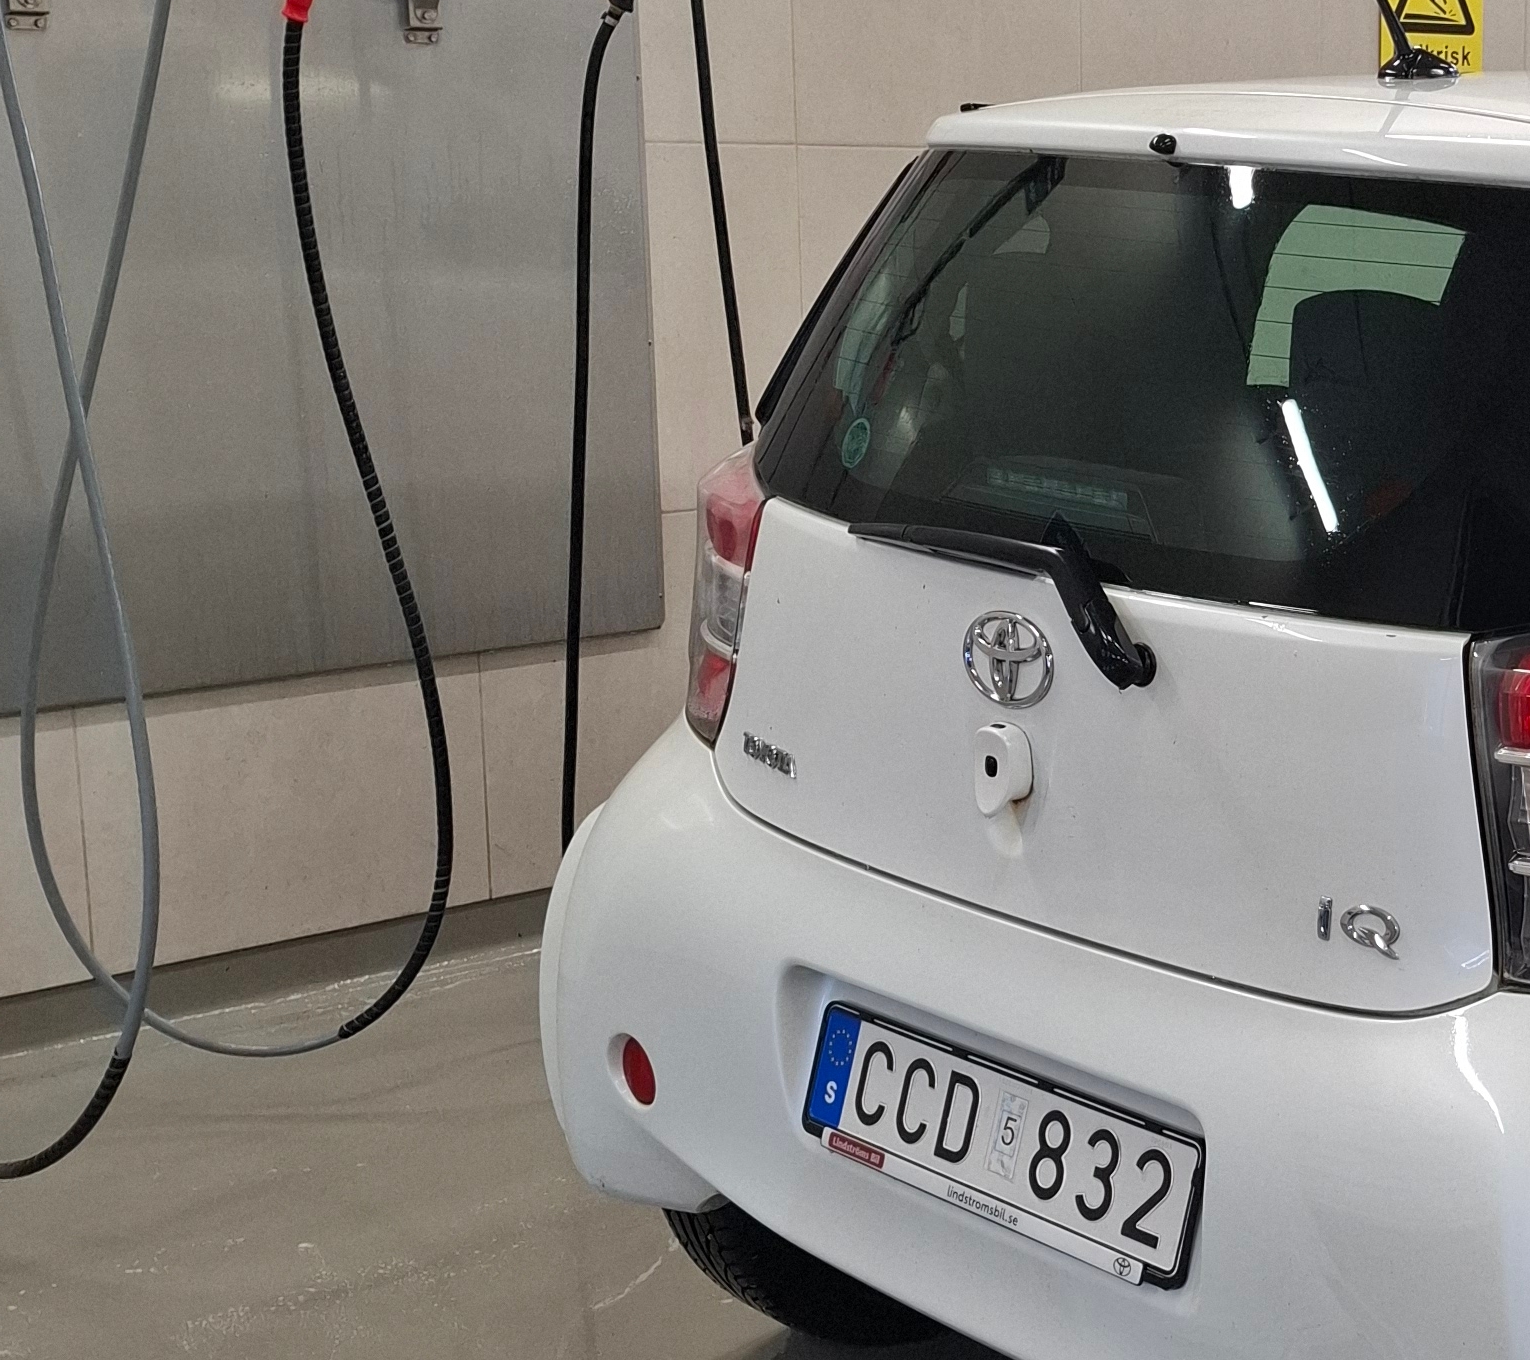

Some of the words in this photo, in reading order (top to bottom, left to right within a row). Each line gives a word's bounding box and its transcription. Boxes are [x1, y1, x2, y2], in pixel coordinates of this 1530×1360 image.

[743, 731, 797, 779] TOYOTA
[824, 1080, 838, 1105] S
[854, 1040, 982, 1164] CCD
[1001, 1116, 1018, 1147] 5
[1028, 1109, 1174, 1250] 832
[946, 1184, 1019, 1227] lindstromsbil.se
